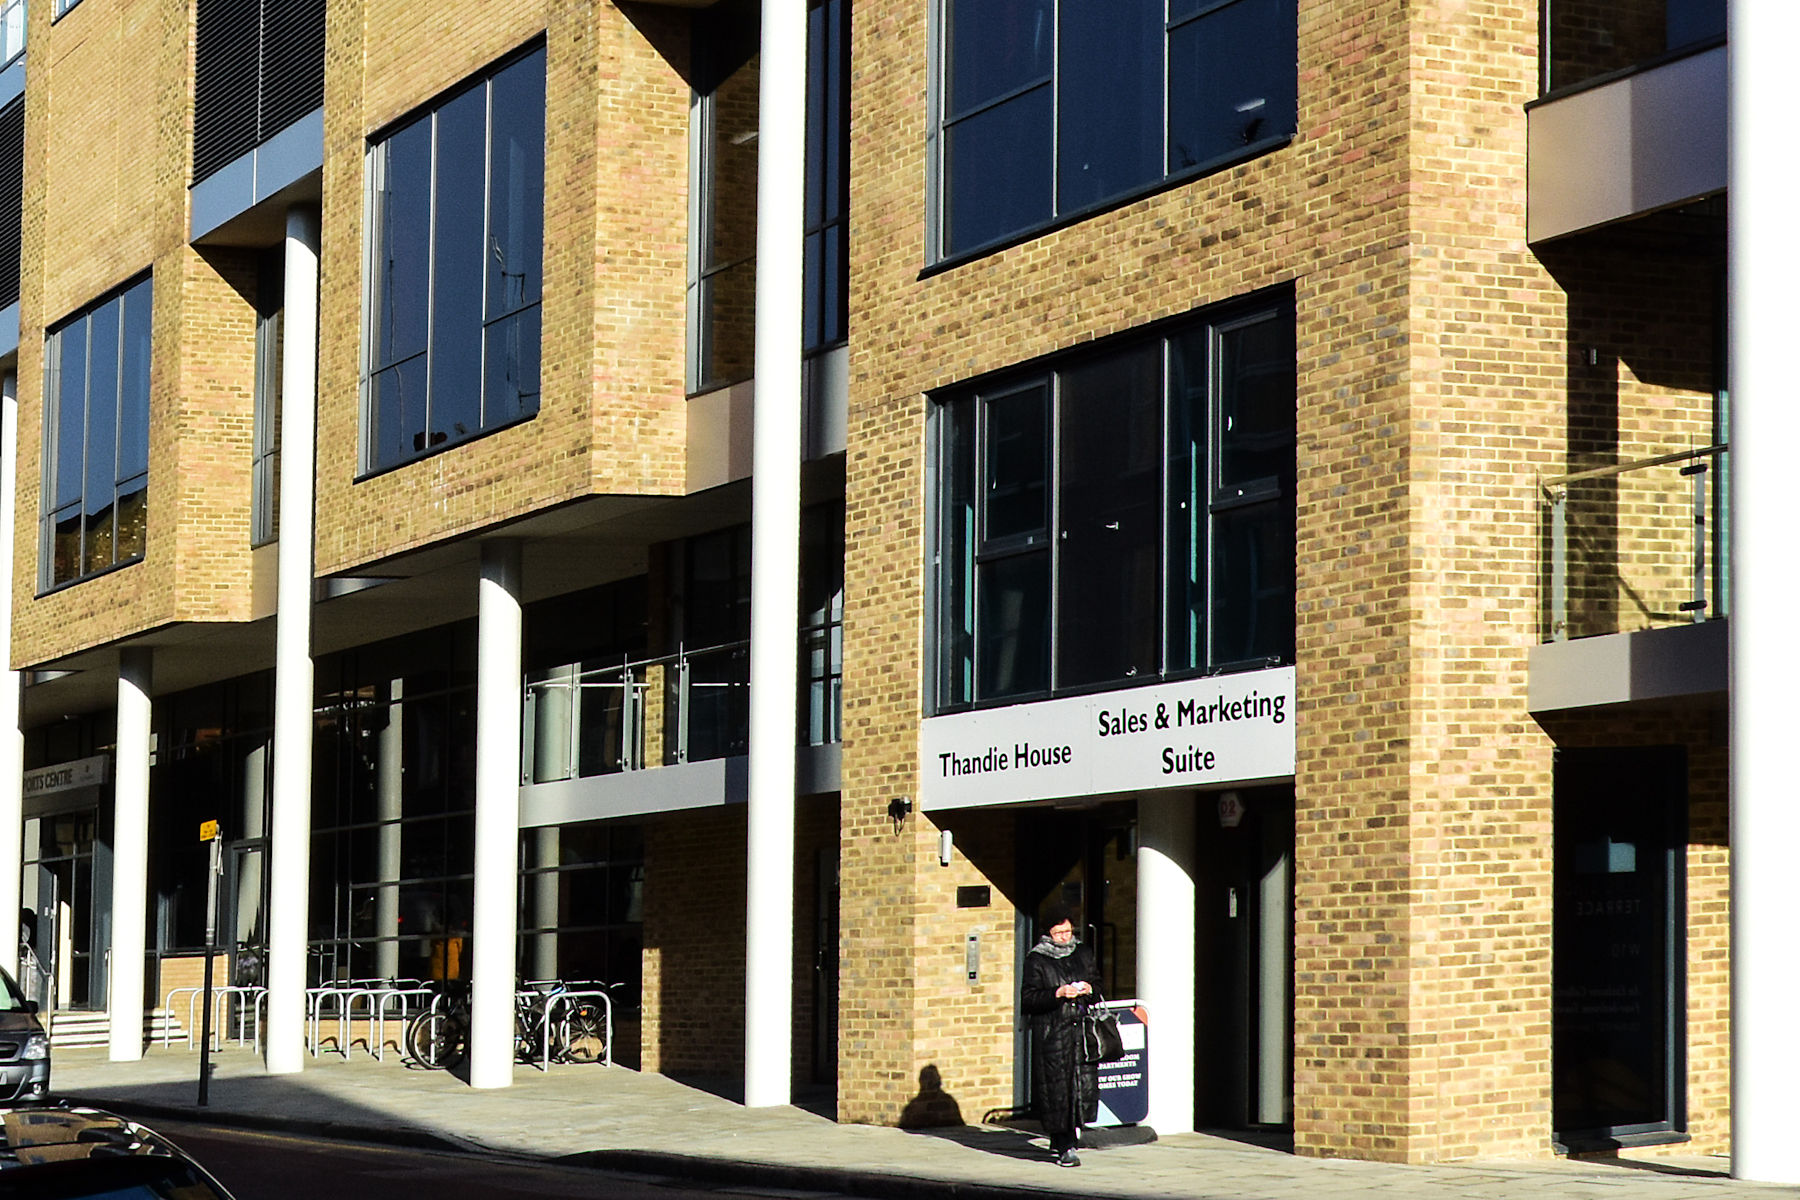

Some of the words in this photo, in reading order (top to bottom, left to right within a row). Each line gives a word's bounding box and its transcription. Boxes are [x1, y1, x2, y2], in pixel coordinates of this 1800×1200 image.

[1098, 708, 1148, 737] Sales
[1154, 703, 1170, 730] &
[1177, 690, 1286, 727] Marketing
[939, 746, 1009, 777] Thandie
[1014, 742, 1072, 769] House
[1162, 745, 1215, 775] Suite
[45, 769, 73, 788] CENTRE
